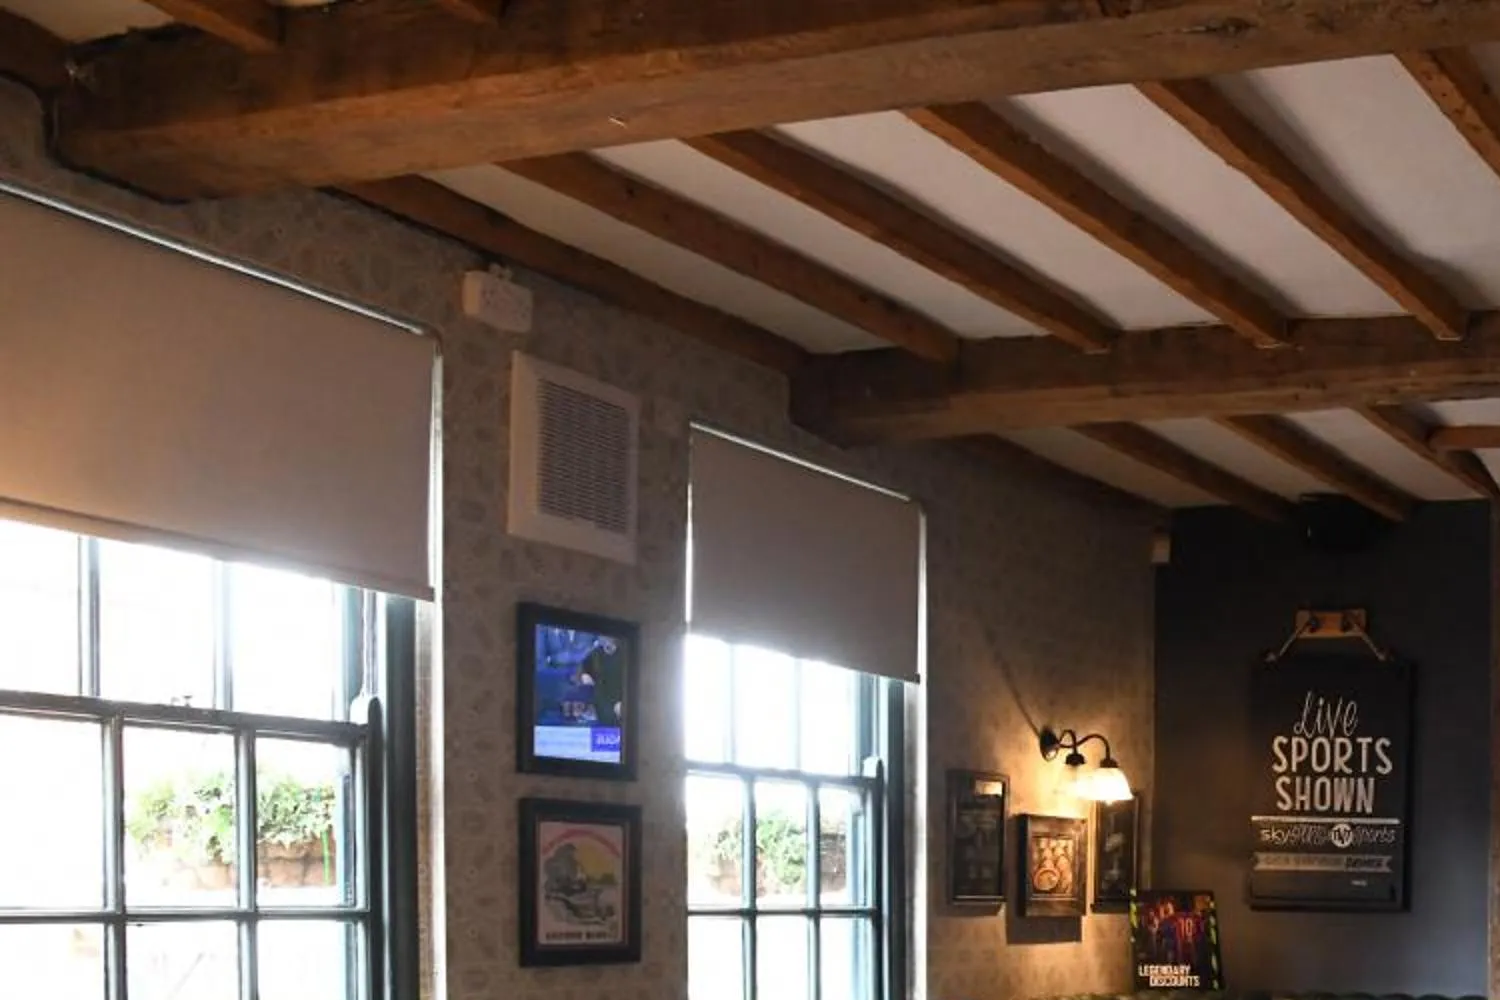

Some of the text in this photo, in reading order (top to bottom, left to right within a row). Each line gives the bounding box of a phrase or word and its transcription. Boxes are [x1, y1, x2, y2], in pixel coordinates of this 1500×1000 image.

[1272, 735, 1393, 775] SPORTS
[1275, 776, 1375, 815] SHOWN
[1138, 964, 1191, 977] LEGENDARY
[1149, 976, 1201, 987] DISCOUNTS
